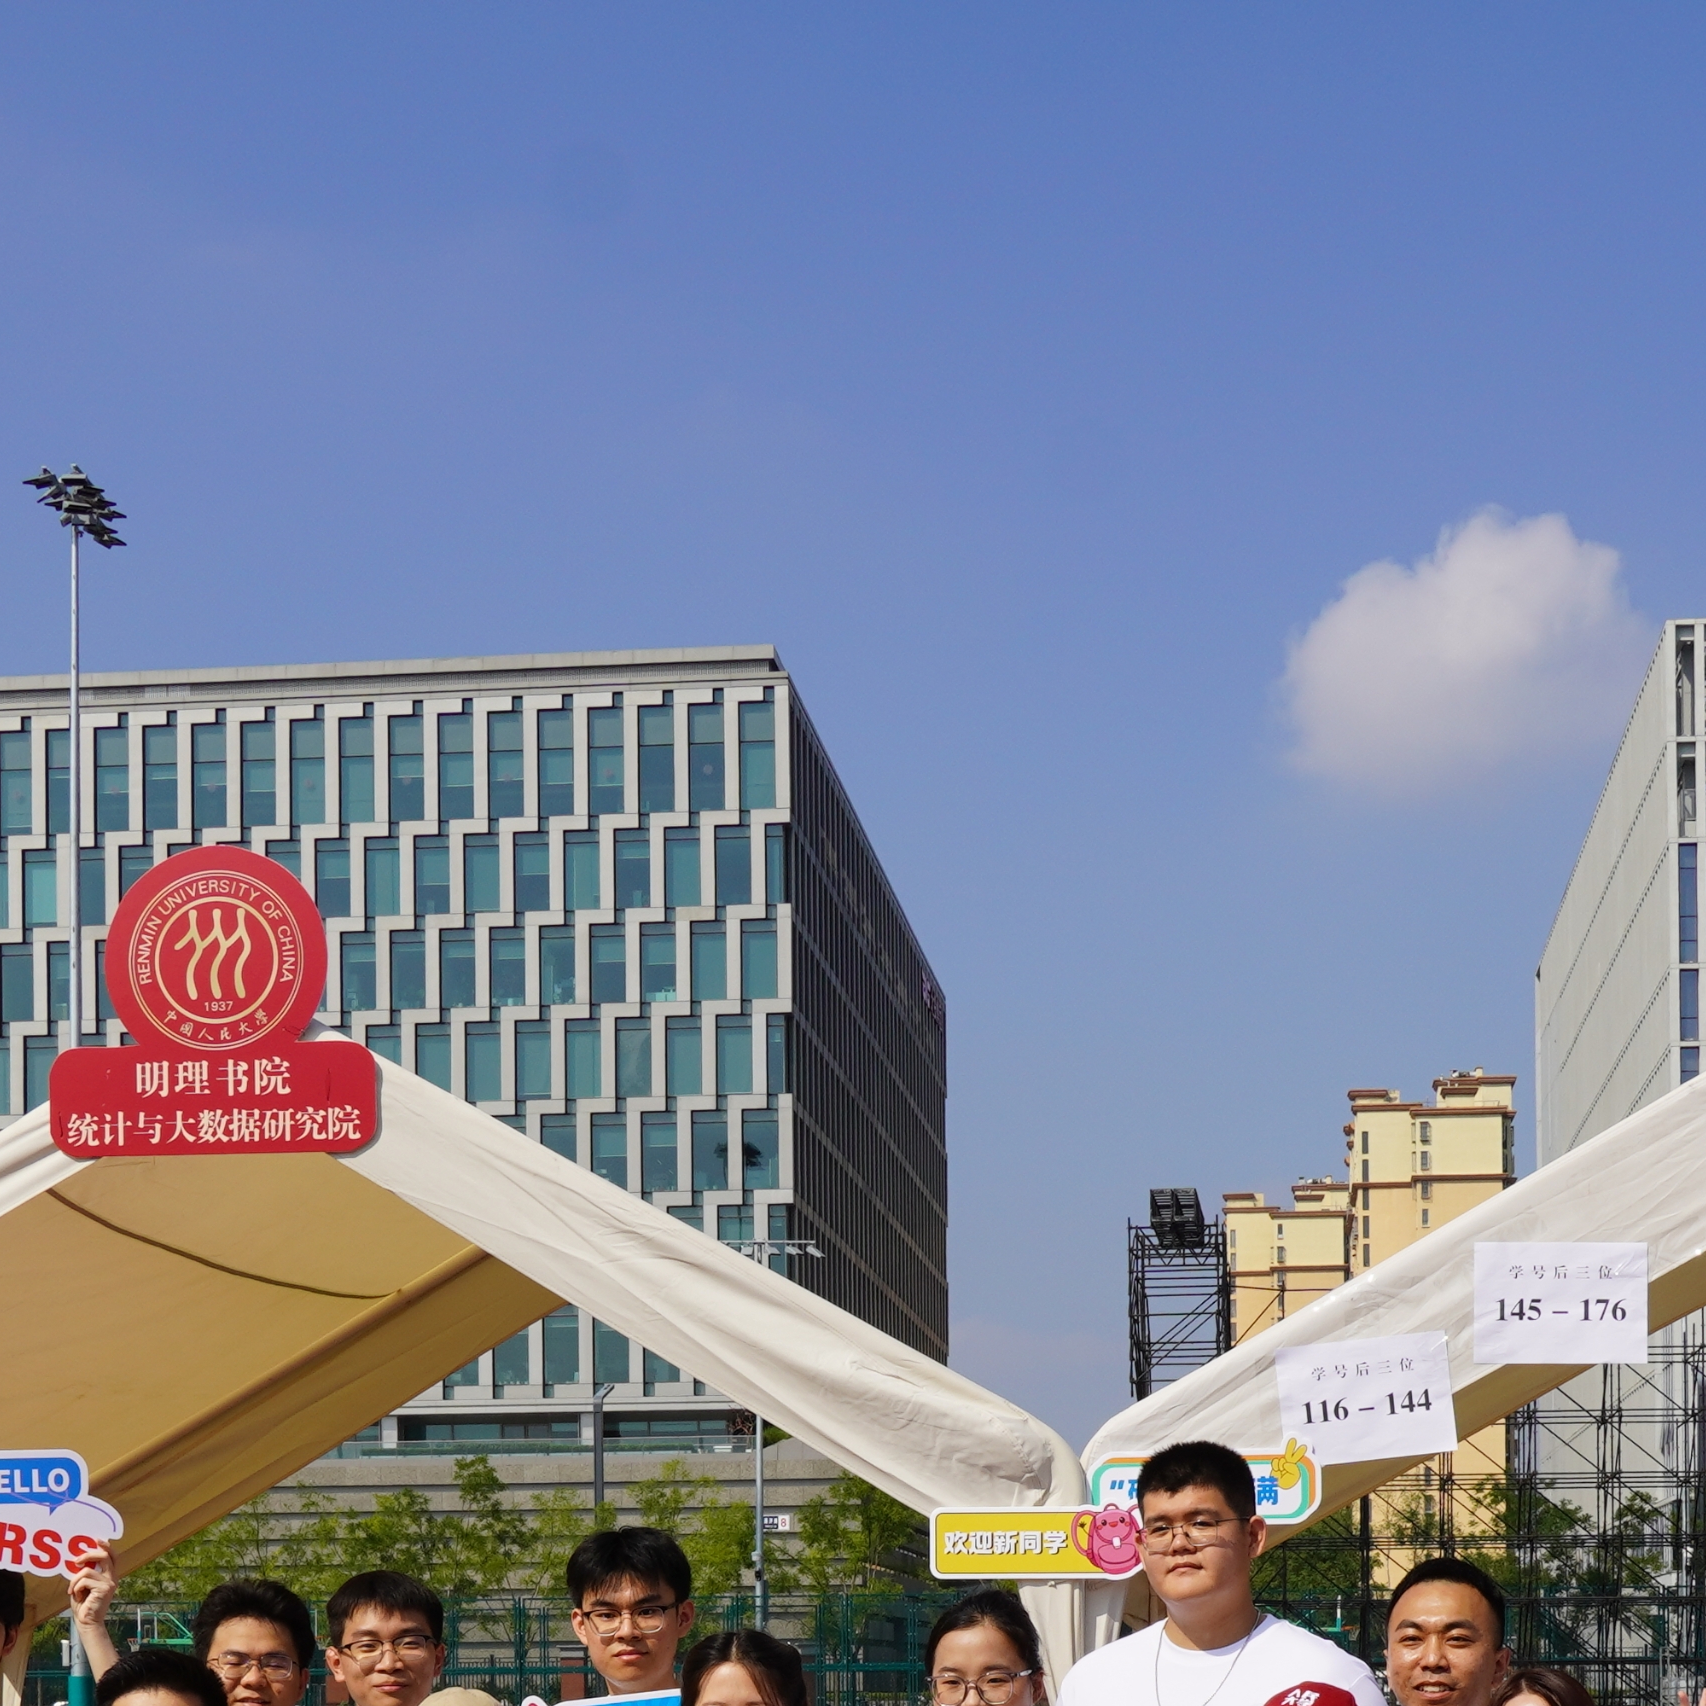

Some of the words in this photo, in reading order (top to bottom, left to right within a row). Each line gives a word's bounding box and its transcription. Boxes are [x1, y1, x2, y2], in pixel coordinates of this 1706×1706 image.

[138, 917, 163, 985] RENMIN
[159, 879, 261, 917] UNIVERSITY
[262, 899, 284, 921] OF
[277, 925, 296, 983] CHINA
[204, 1000, 234, 1012] 1937
[135, 1056, 292, 1098] 明理书院
[67, 1104, 362, 1147] 统计与大数据研究院
[1508, 1264, 1615, 1280] 学号后三位
[1495, 1298, 1542, 1322] 145
[1579, 1298, 1627, 1322] 176
[1311, 1356, 1416, 1382] 学号后三位
[1301, 1396, 1349, 1425] 116
[1385, 1388, 1432, 1416] 144
[943, 1529, 1068, 1556] 欢迎新同学
